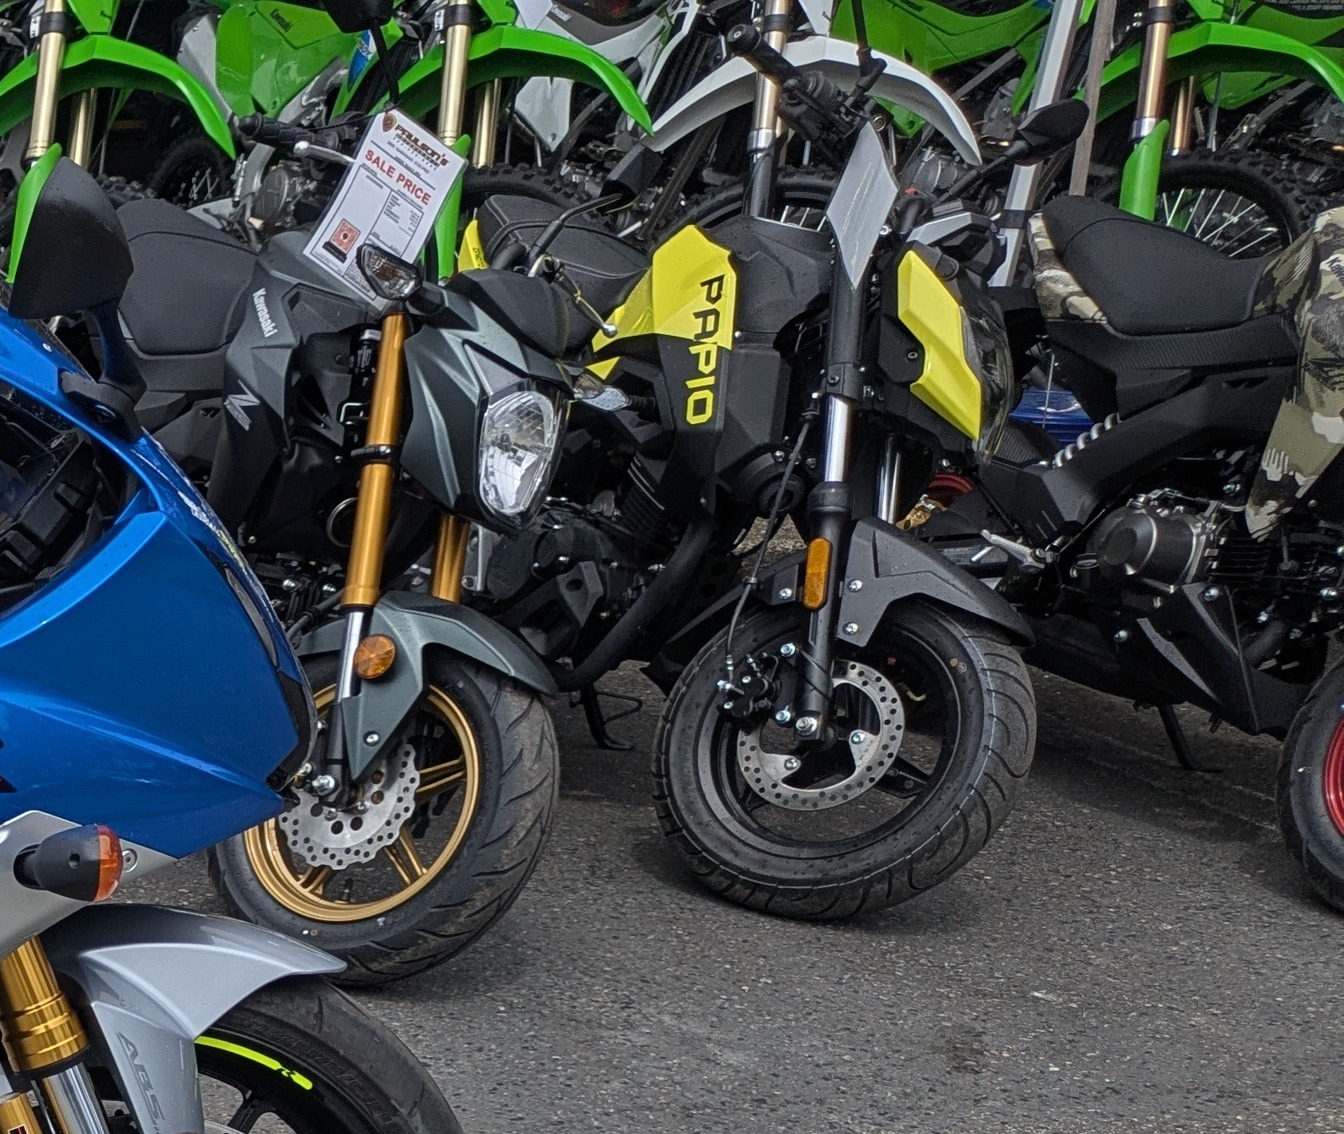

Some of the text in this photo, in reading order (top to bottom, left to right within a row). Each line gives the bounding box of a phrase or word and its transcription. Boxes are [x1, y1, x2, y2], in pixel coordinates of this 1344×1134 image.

[365, 149, 395, 179] SALE
[396, 173, 432, 205] PRICE
[253, 288, 278, 338] Kawasaki
[685, 274, 726, 425] PAPIO
[115, 1031, 164, 1127] ABS
